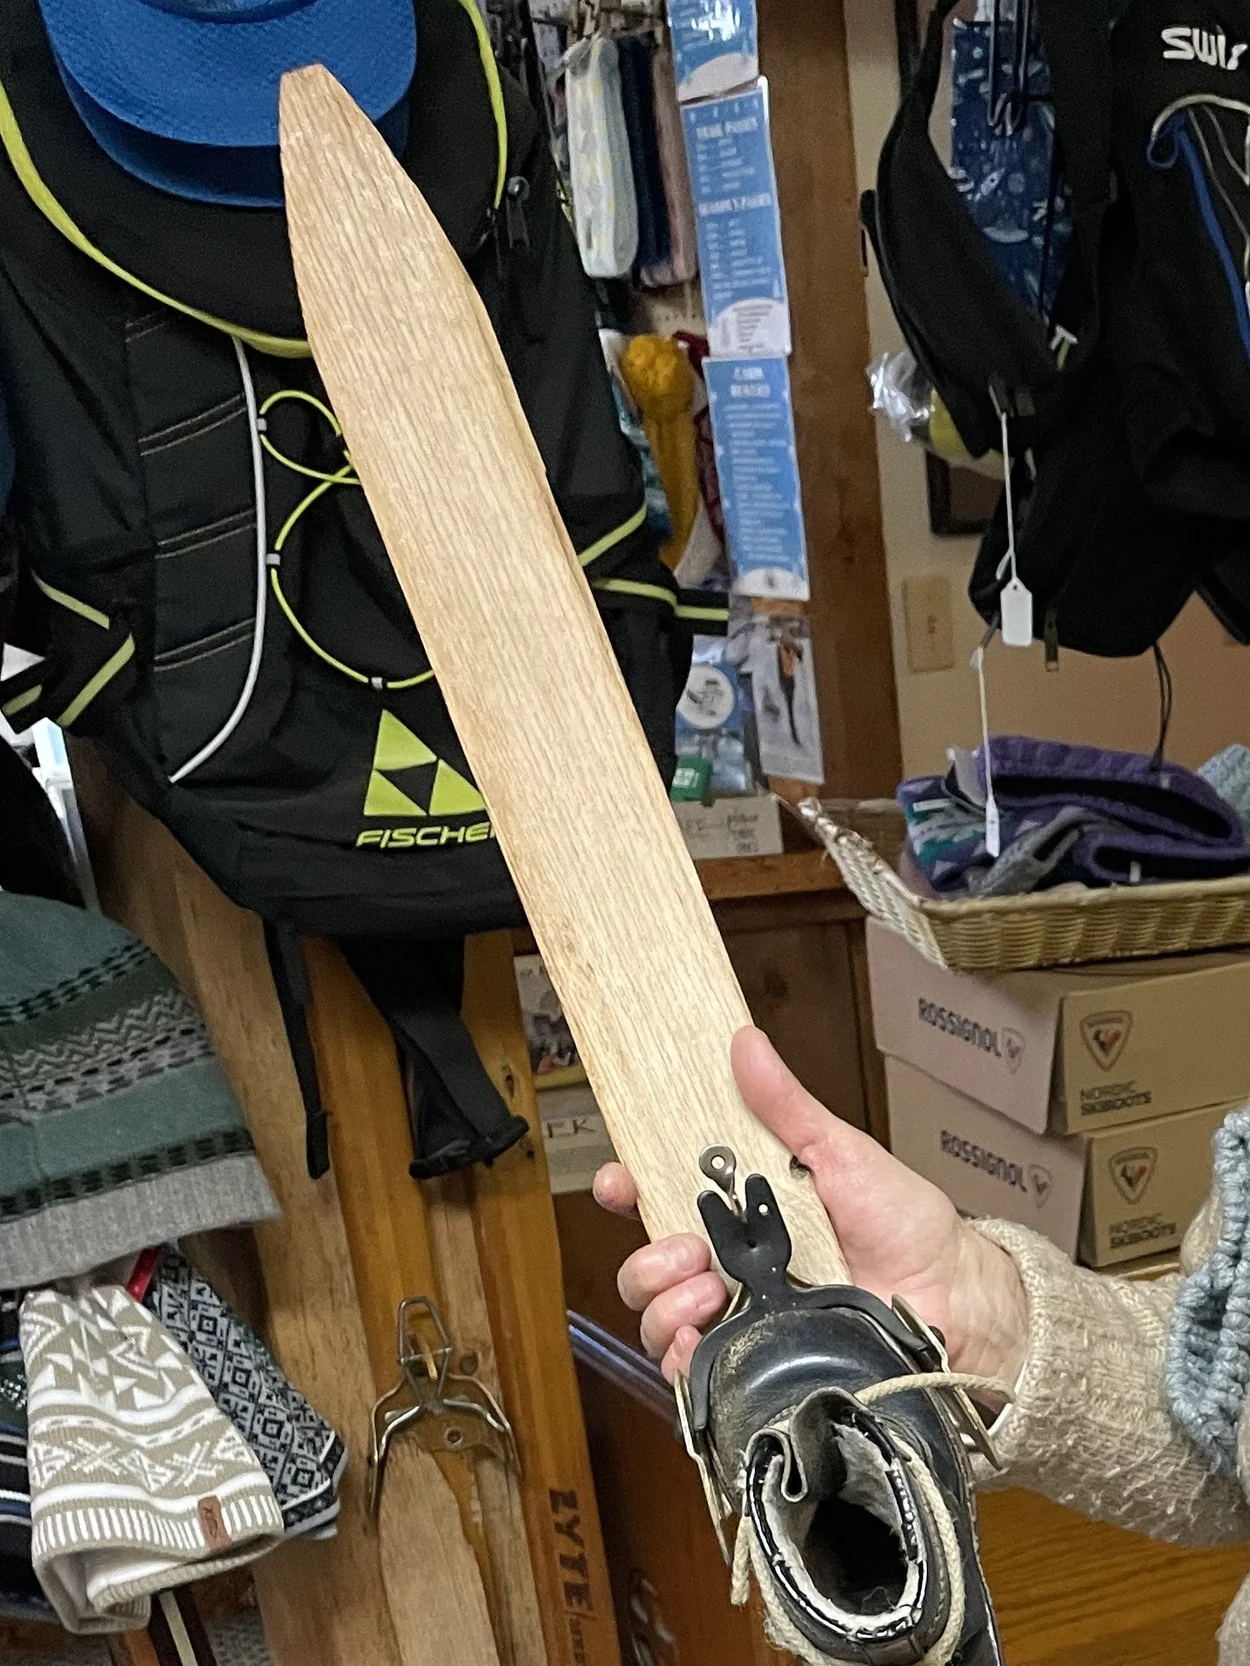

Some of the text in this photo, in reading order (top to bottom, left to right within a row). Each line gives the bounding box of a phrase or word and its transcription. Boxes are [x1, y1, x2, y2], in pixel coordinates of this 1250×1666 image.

[355, 821, 497, 849] FISCHE
[918, 998, 1002, 1058] ROSSIGNOL
[940, 1129, 1028, 1193] ROSSIGNOL
